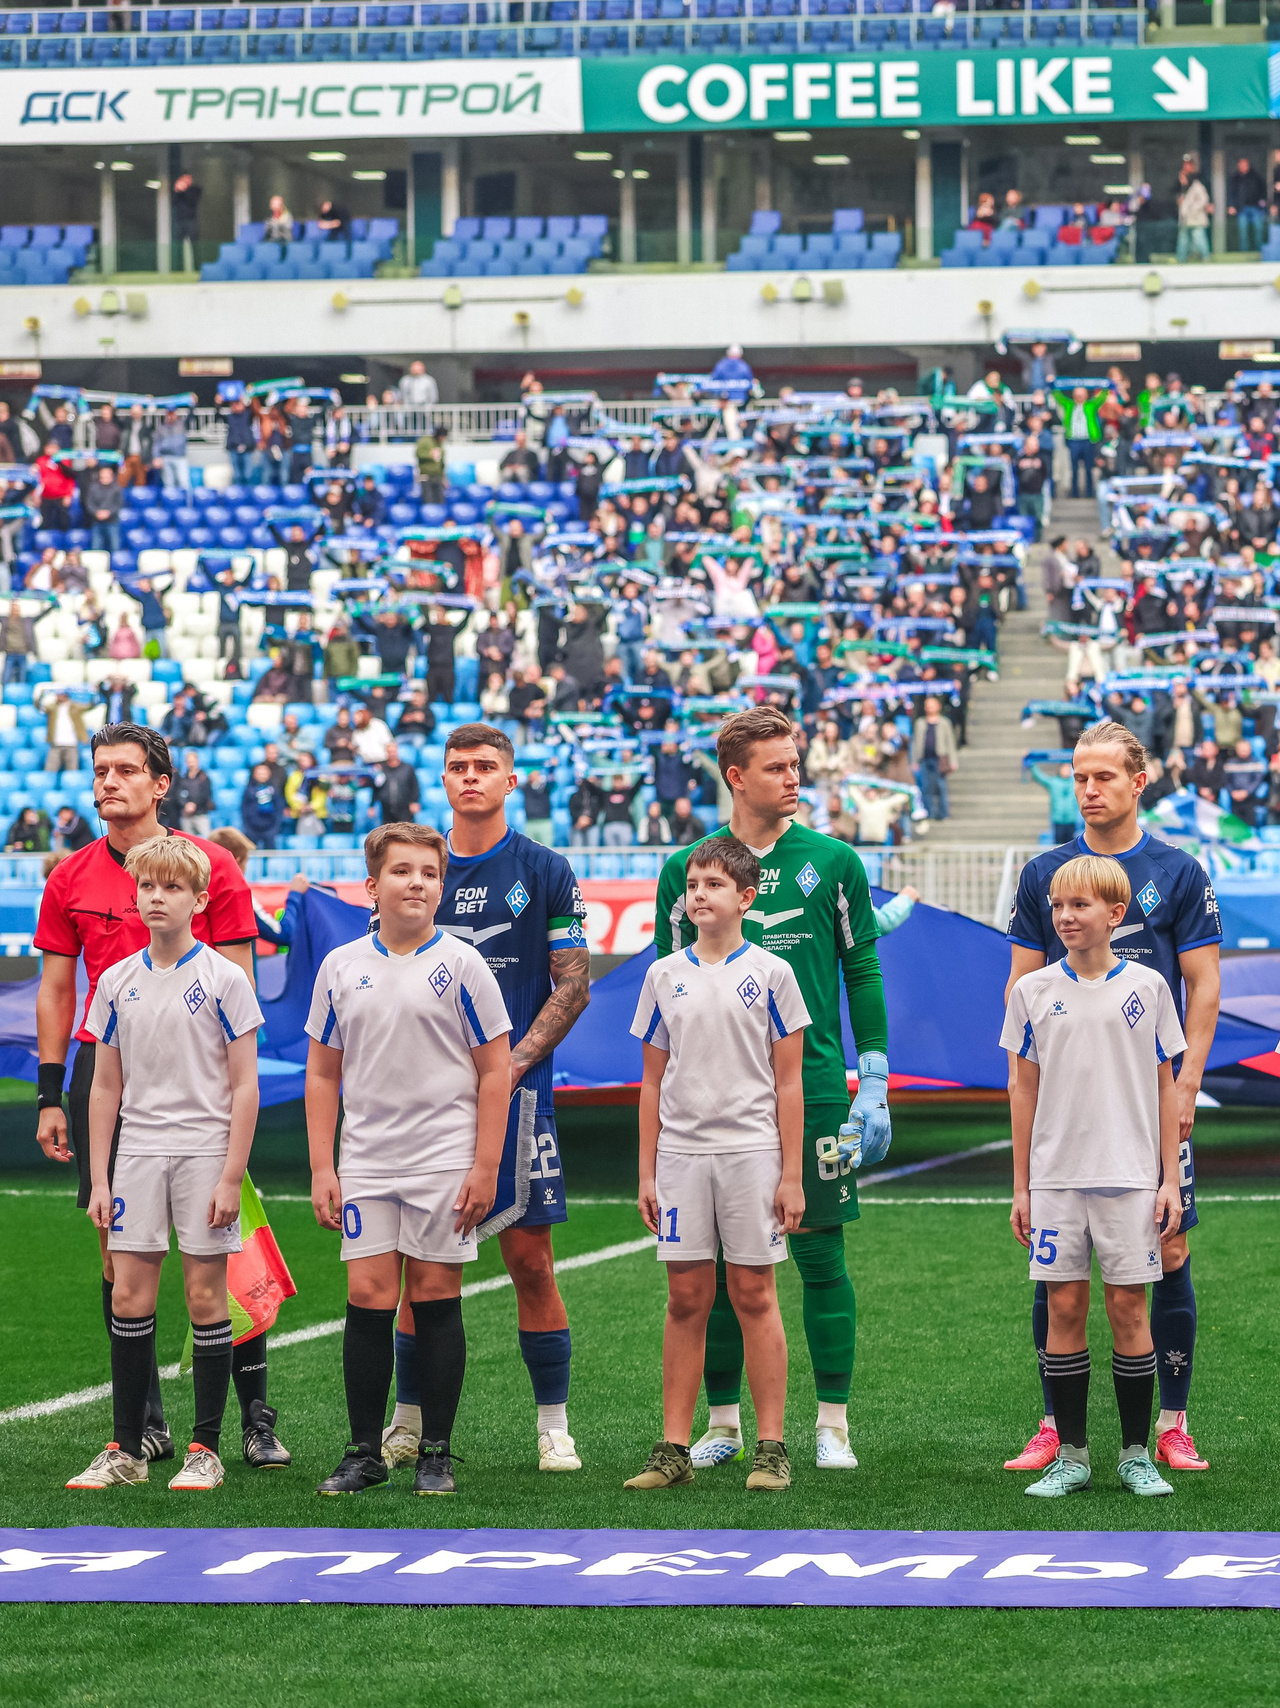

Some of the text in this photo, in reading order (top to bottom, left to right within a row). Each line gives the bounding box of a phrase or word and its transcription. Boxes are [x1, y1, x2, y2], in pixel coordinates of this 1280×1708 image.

[637, 56, 1115, 124] COFFEE LIKE
[20, 72, 543, 126] ДСК ТРАНССТРОЙ
[758, 868, 780, 881] ON
[455, 886, 488, 901] FON
[572, 887, 582, 899] FO
[757, 881, 780, 894] ET
[1204, 886, 1215, 899] FO
[455, 900, 487, 914] BET
[574, 900, 586, 912] BE
[1206, 901, 1220, 914] BE
[762, 933, 813, 941] ПРАВИТЕЛЬСТВО
[762, 938, 801, 946] САМАРСКОЙ
[484, 956, 520, 964] ИТЕЛЬСТВО
[355, 983, 374, 991] KELME
[341, 1203, 363, 1240] 0
[1173, 1366, 1180, 1376] 2
